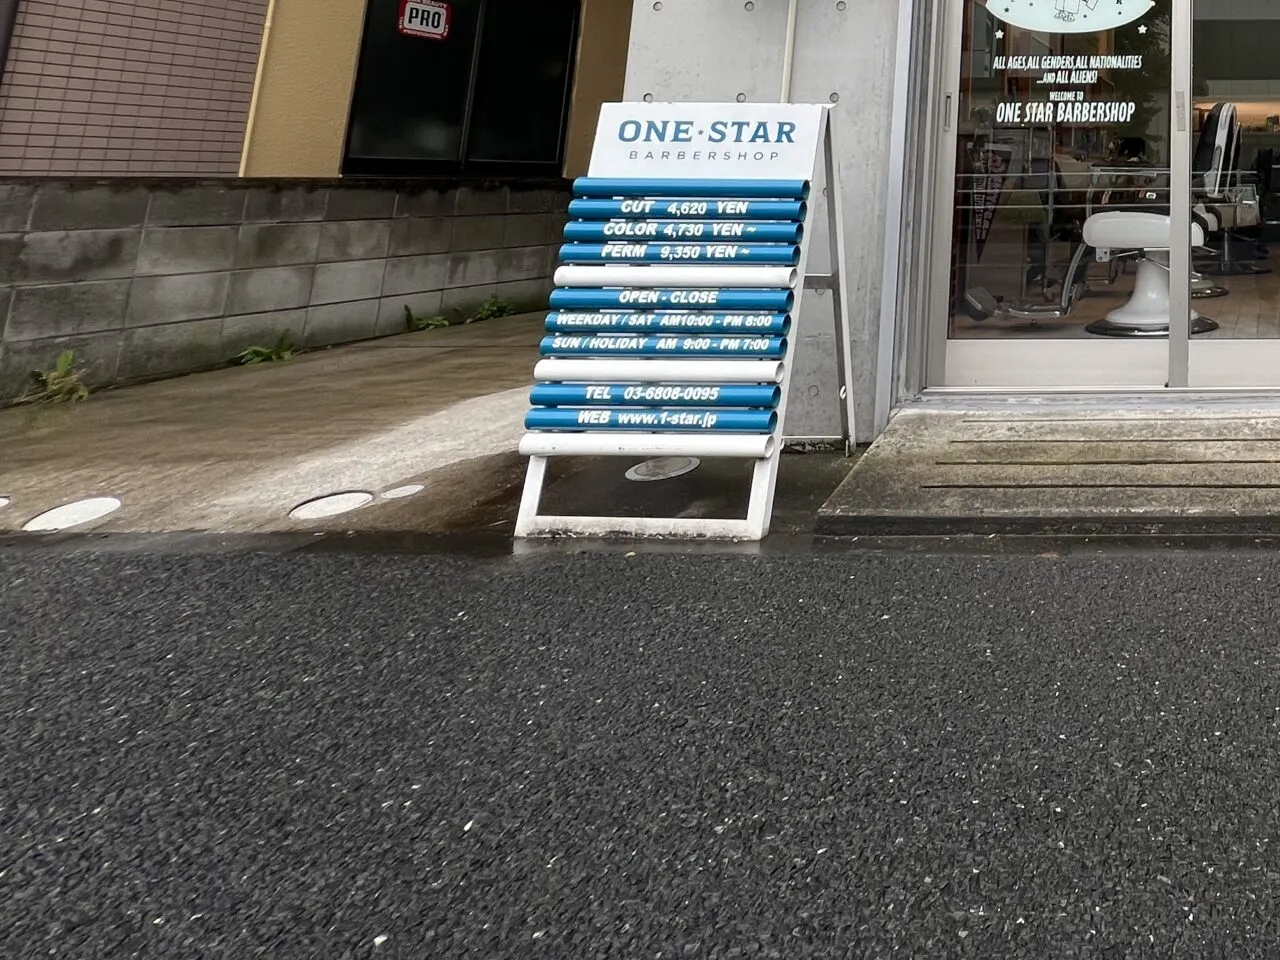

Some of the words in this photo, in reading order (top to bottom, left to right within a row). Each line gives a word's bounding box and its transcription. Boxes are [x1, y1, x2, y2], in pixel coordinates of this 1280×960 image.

[407, 7, 442, 30] PRO
[993, 55, 1006, 69] ALL
[1089, 55, 1143, 69] NATIONALITIES
[1056, 70, 1069, 84] ALL
[1070, 70, 1098, 84] ALIENS!
[1050, 91, 1076, 101] WELCOME
[1076, 91, 1084, 101] TO
[996, 102, 1021, 123] ONE
[1024, 102, 1054, 123] STAR
[1056, 102, 1136, 123] BARBERSHOP
[618, 119, 694, 143] ONE
[708, 120, 797, 144] STAR
[629, 150, 780, 161] BARBERSHOP
[620, 200, 656, 213] CUT
[667, 201, 708, 217] 4,620
[716, 201, 749, 214] YEN
[603, 222, 658, 236] COLOR
[663, 223, 704, 238] 4,730
[712, 223, 745, 236] YEN
[601, 244, 648, 258] PERM
[660, 245, 701, 260] 9,350
[705, 245, 738, 258] YEN
[619, 291, 661, 304] OPEN
[670, 291, 719, 304] CLOSE
[556, 313, 619, 326] WEEKDAY
[629, 314, 655, 326] SAT
[722, 315, 744, 327] PM
[745, 315, 773, 327] 8:00
[552, 337, 581, 349] SUN
[589, 337, 648, 349] HOLIDAY
[656, 338, 677, 349] AM
[682, 338, 710, 350] 9:00
[719, 338, 740, 350] PM
[743, 338, 770, 350] 7:00
[585, 386, 612, 399] TEL
[624, 386, 720, 400] 03-6808-0095
[577, 410, 612, 424] WEB
[617, 411, 717, 428] www.1-star.jp
